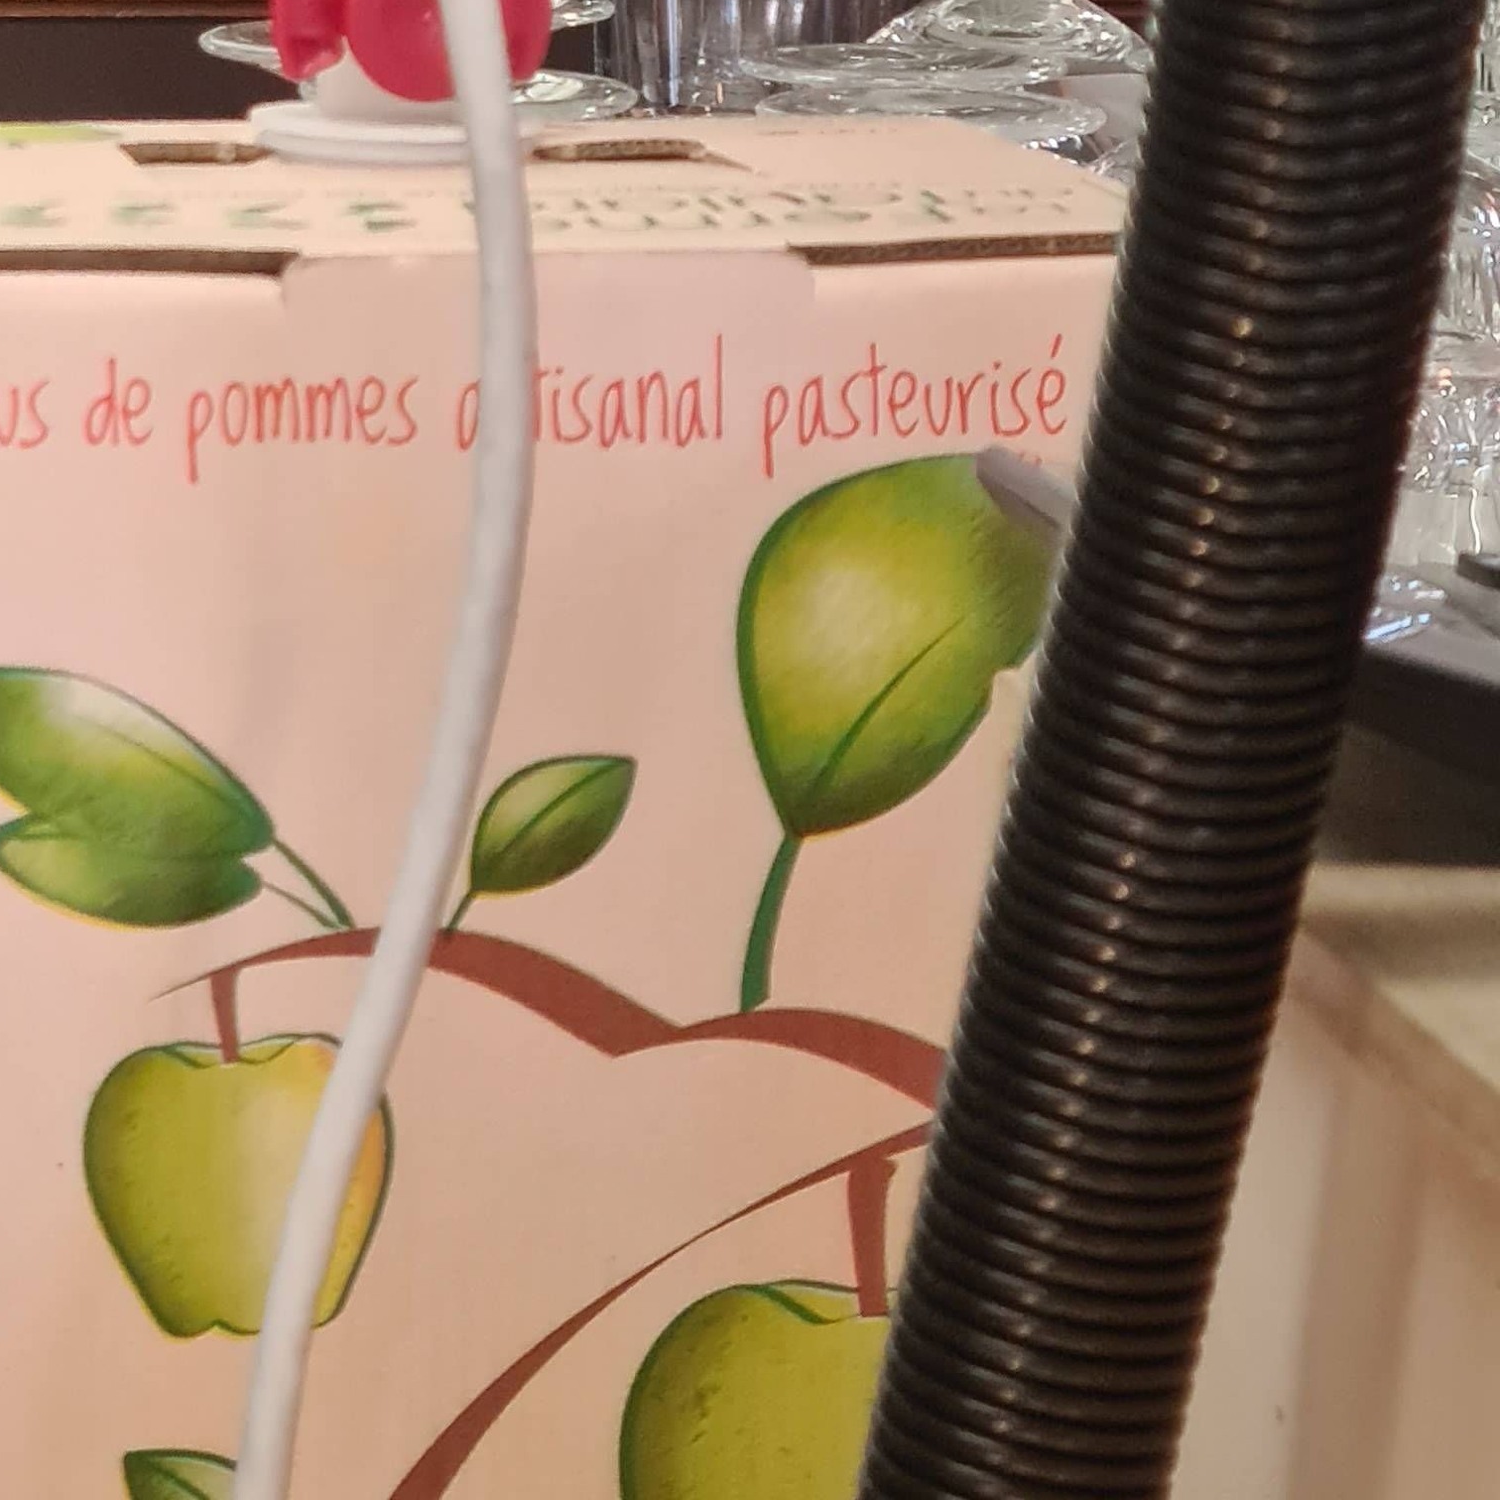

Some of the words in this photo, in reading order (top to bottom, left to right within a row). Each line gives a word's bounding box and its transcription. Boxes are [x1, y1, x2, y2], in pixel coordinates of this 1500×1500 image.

[83, 357, 153, 447] de
[186, 375, 420, 485] pommes
[457, 333, 723, 451] atisanal
[763, 333, 1068, 479] pasteurisé
